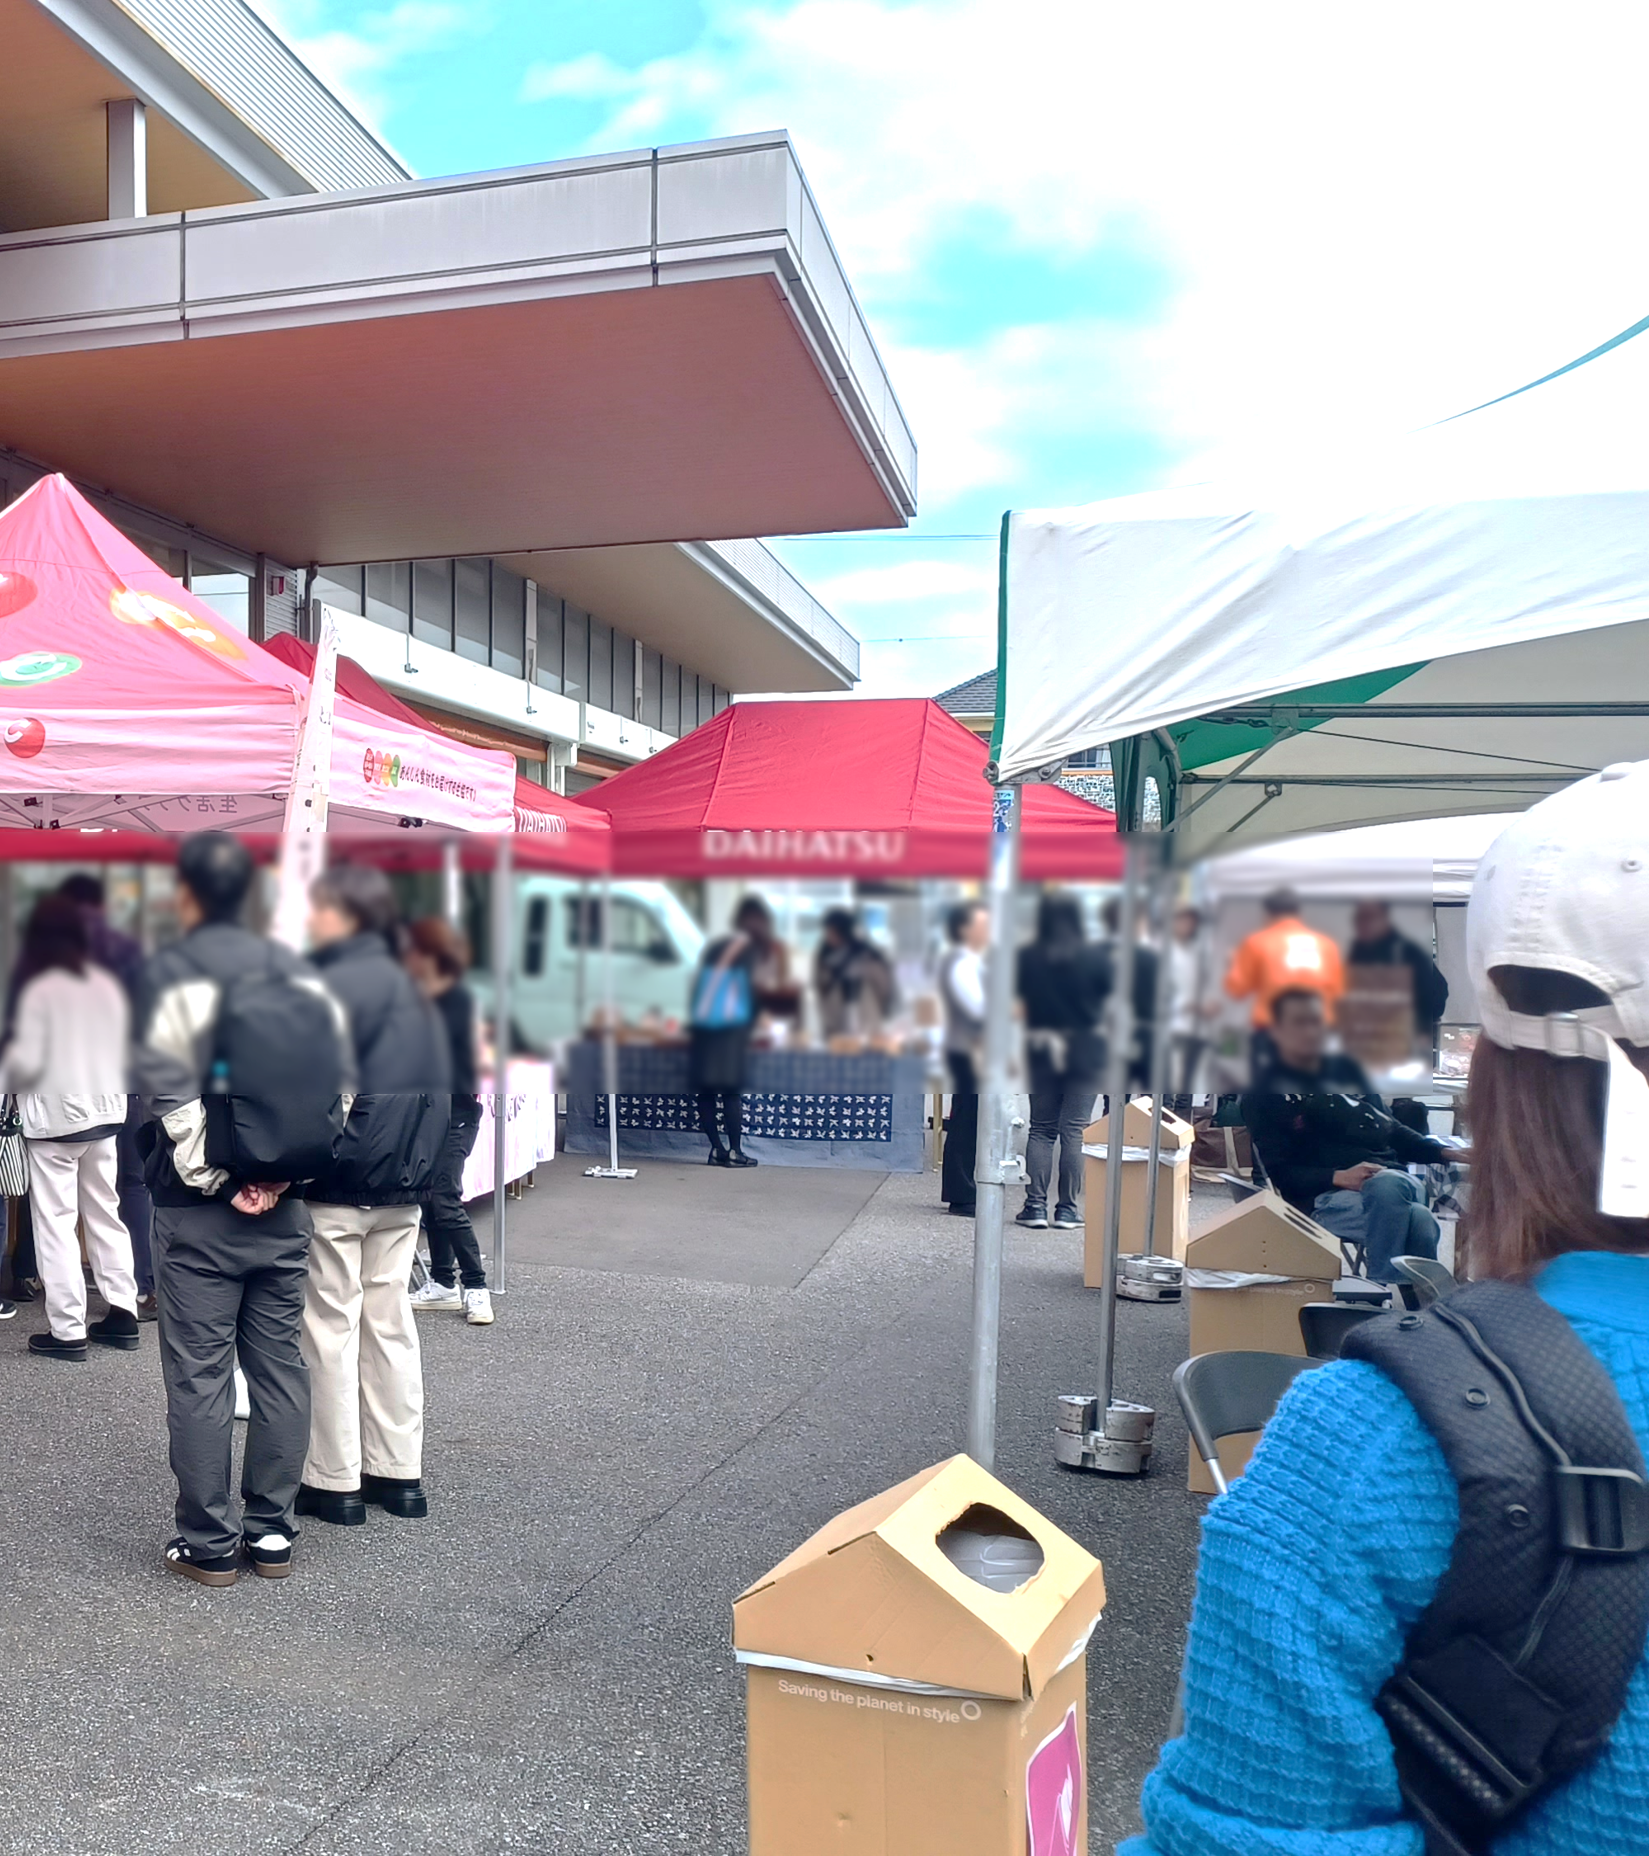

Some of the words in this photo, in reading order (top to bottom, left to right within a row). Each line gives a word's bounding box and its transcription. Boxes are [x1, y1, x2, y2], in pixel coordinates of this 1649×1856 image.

[704, 829, 907, 862] DAIHATSU
[778, 1679, 828, 1702] Saving
[829, 1689, 854, 1704] the
[856, 1695, 904, 1713] planet
[907, 1702, 921, 1716] in
[923, 1707, 960, 1723] style
